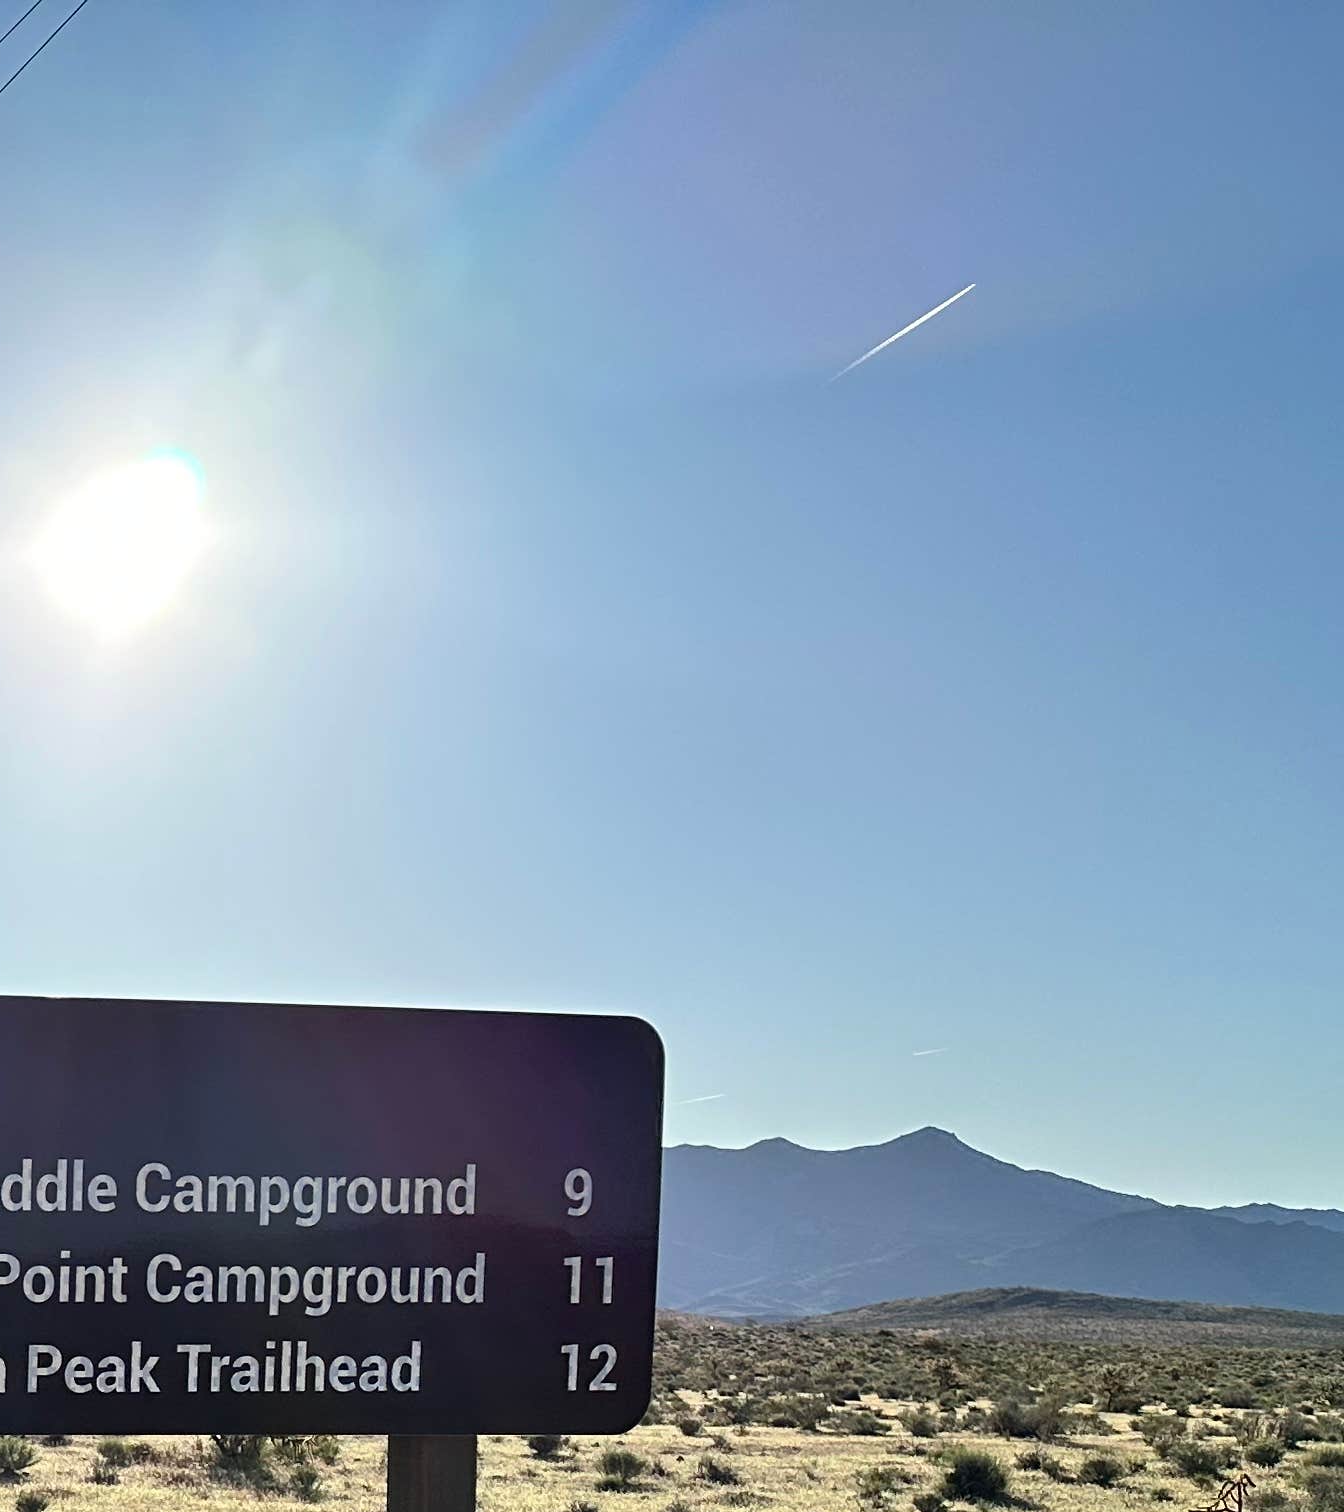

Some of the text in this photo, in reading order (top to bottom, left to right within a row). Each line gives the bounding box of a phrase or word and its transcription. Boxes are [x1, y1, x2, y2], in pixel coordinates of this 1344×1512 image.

[135, 1162, 477, 1226] Campground
[564, 1168, 593, 1217] 9
[146, 1253, 486, 1317] Campground
[563, 1256, 614, 1304] 11
[27, 1341, 162, 1394] Peak
[176, 1341, 422, 1393] Trailhead
[560, 1343, 618, 1392] 12
